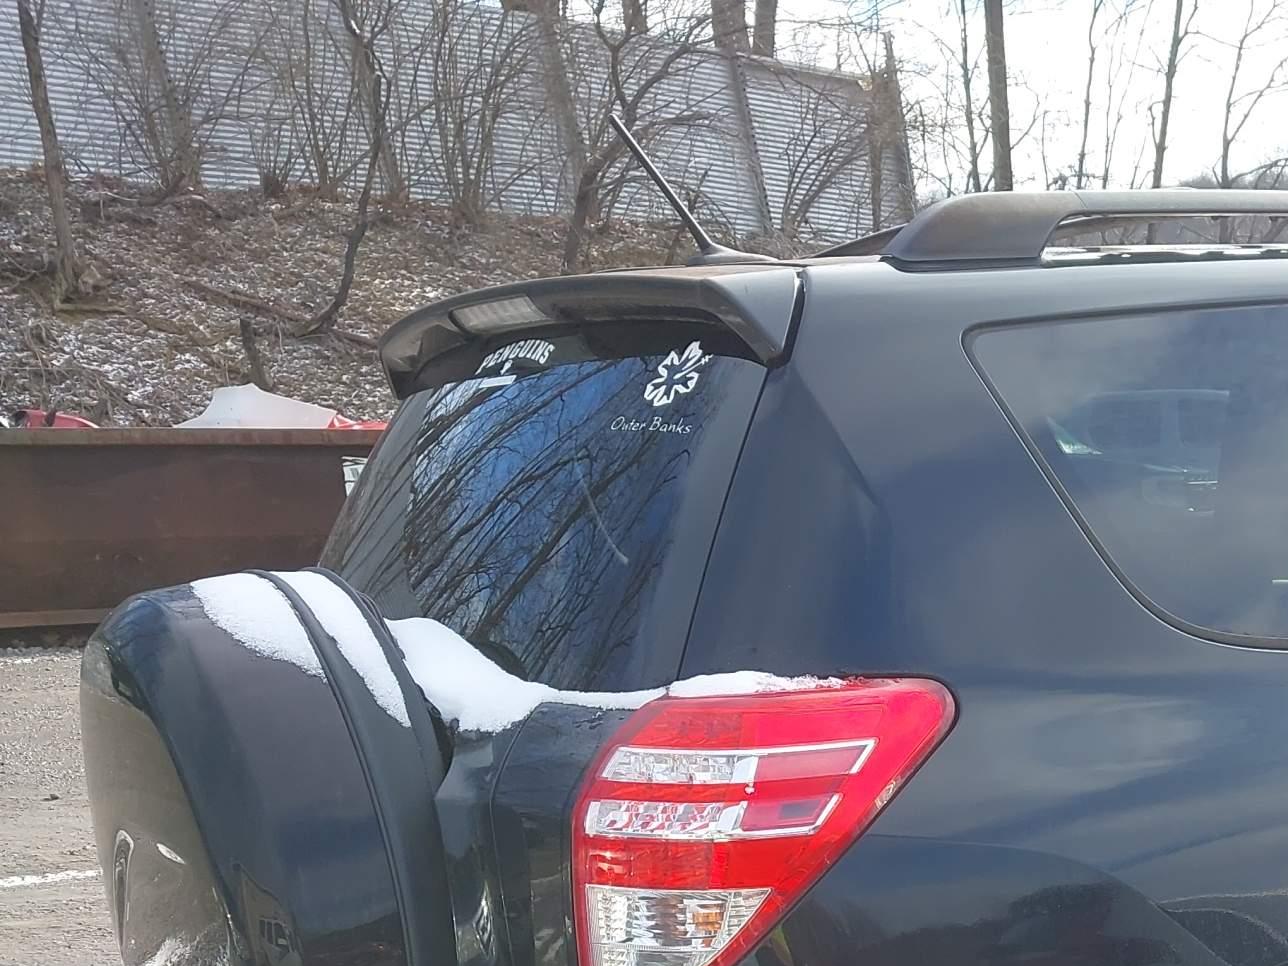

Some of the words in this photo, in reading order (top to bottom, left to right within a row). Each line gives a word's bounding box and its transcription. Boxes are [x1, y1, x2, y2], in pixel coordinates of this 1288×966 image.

[475, 339, 555, 375] PENGUINS
[610, 415, 646, 431] Outer
[648, 416, 693, 434] Banks
